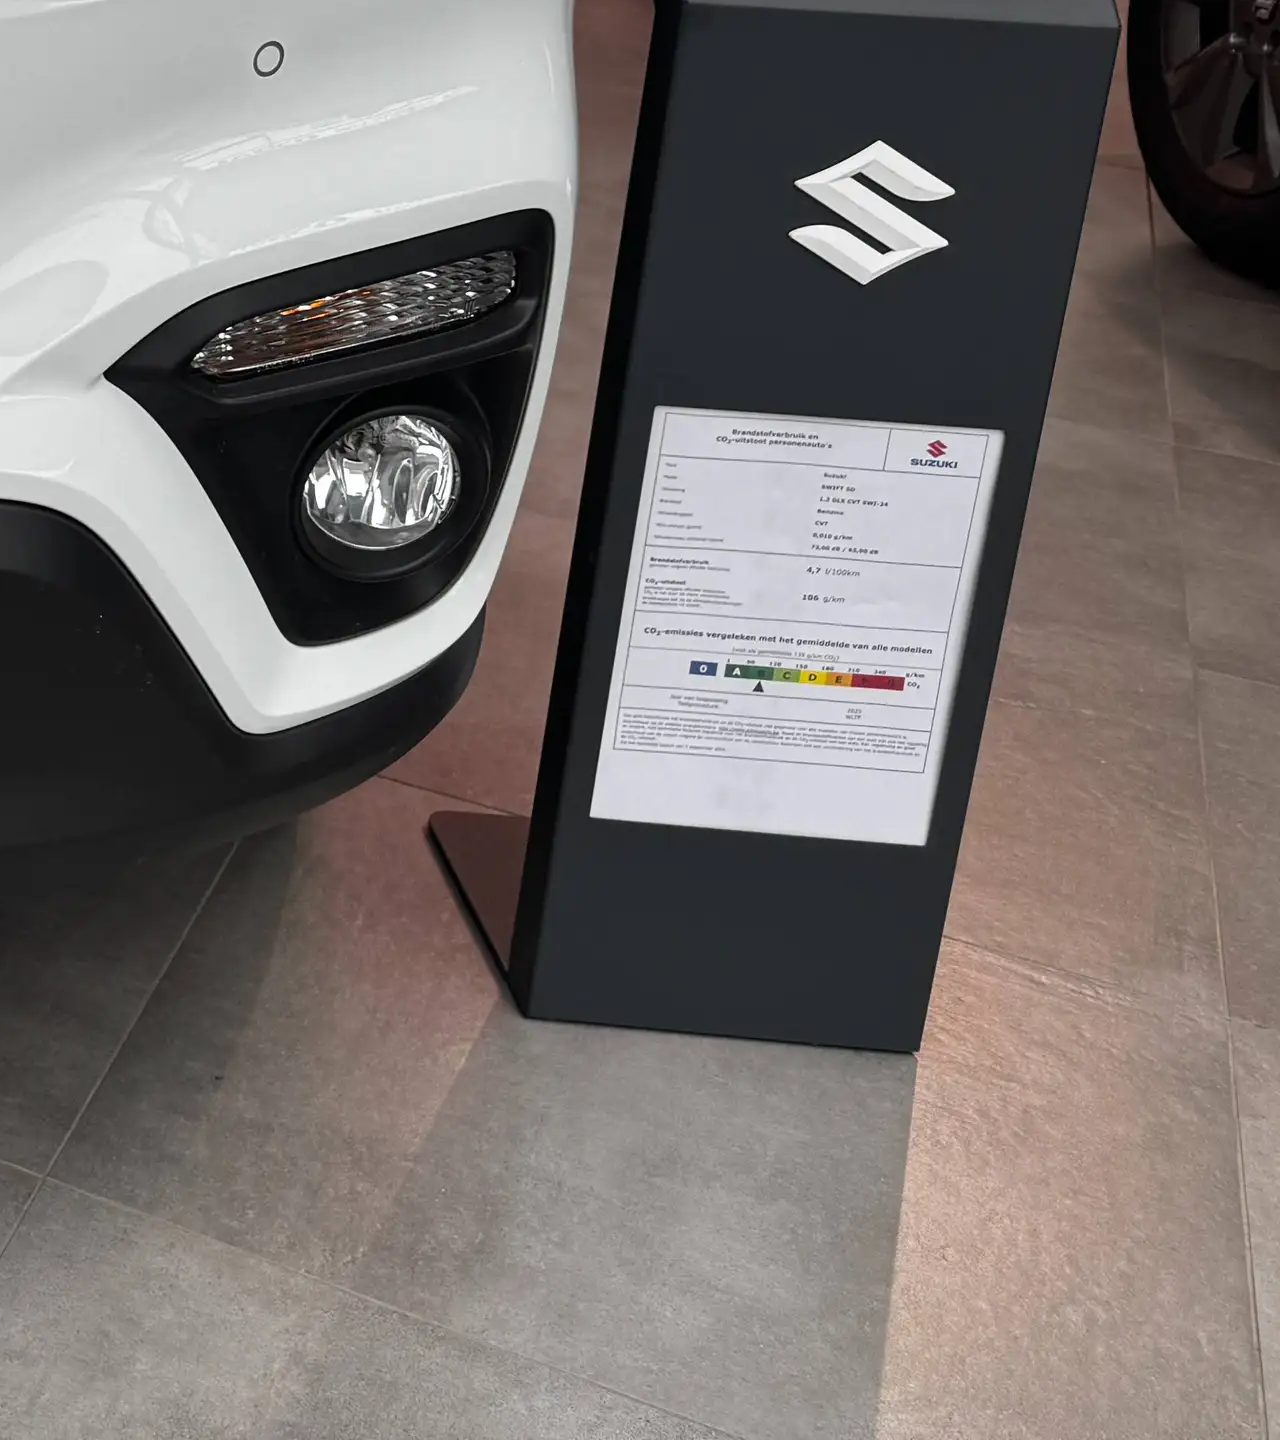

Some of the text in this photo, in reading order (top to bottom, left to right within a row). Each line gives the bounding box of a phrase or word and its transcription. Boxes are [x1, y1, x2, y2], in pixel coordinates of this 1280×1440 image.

[910, 458, 958, 469] SUZUKI
[806, 566, 821, 575] 4,7
[823, 596, 845, 604] g/km
[706, 631, 756, 641] vergeleken
[779, 636, 794, 644] het
[796, 638, 850, 649] gemiddelde
[890, 646, 933, 655] modellen
[732, 667, 741, 676] A
[782, 671, 792, 680] C
[808, 673, 817, 681] D
[835, 675, 843, 684] E
